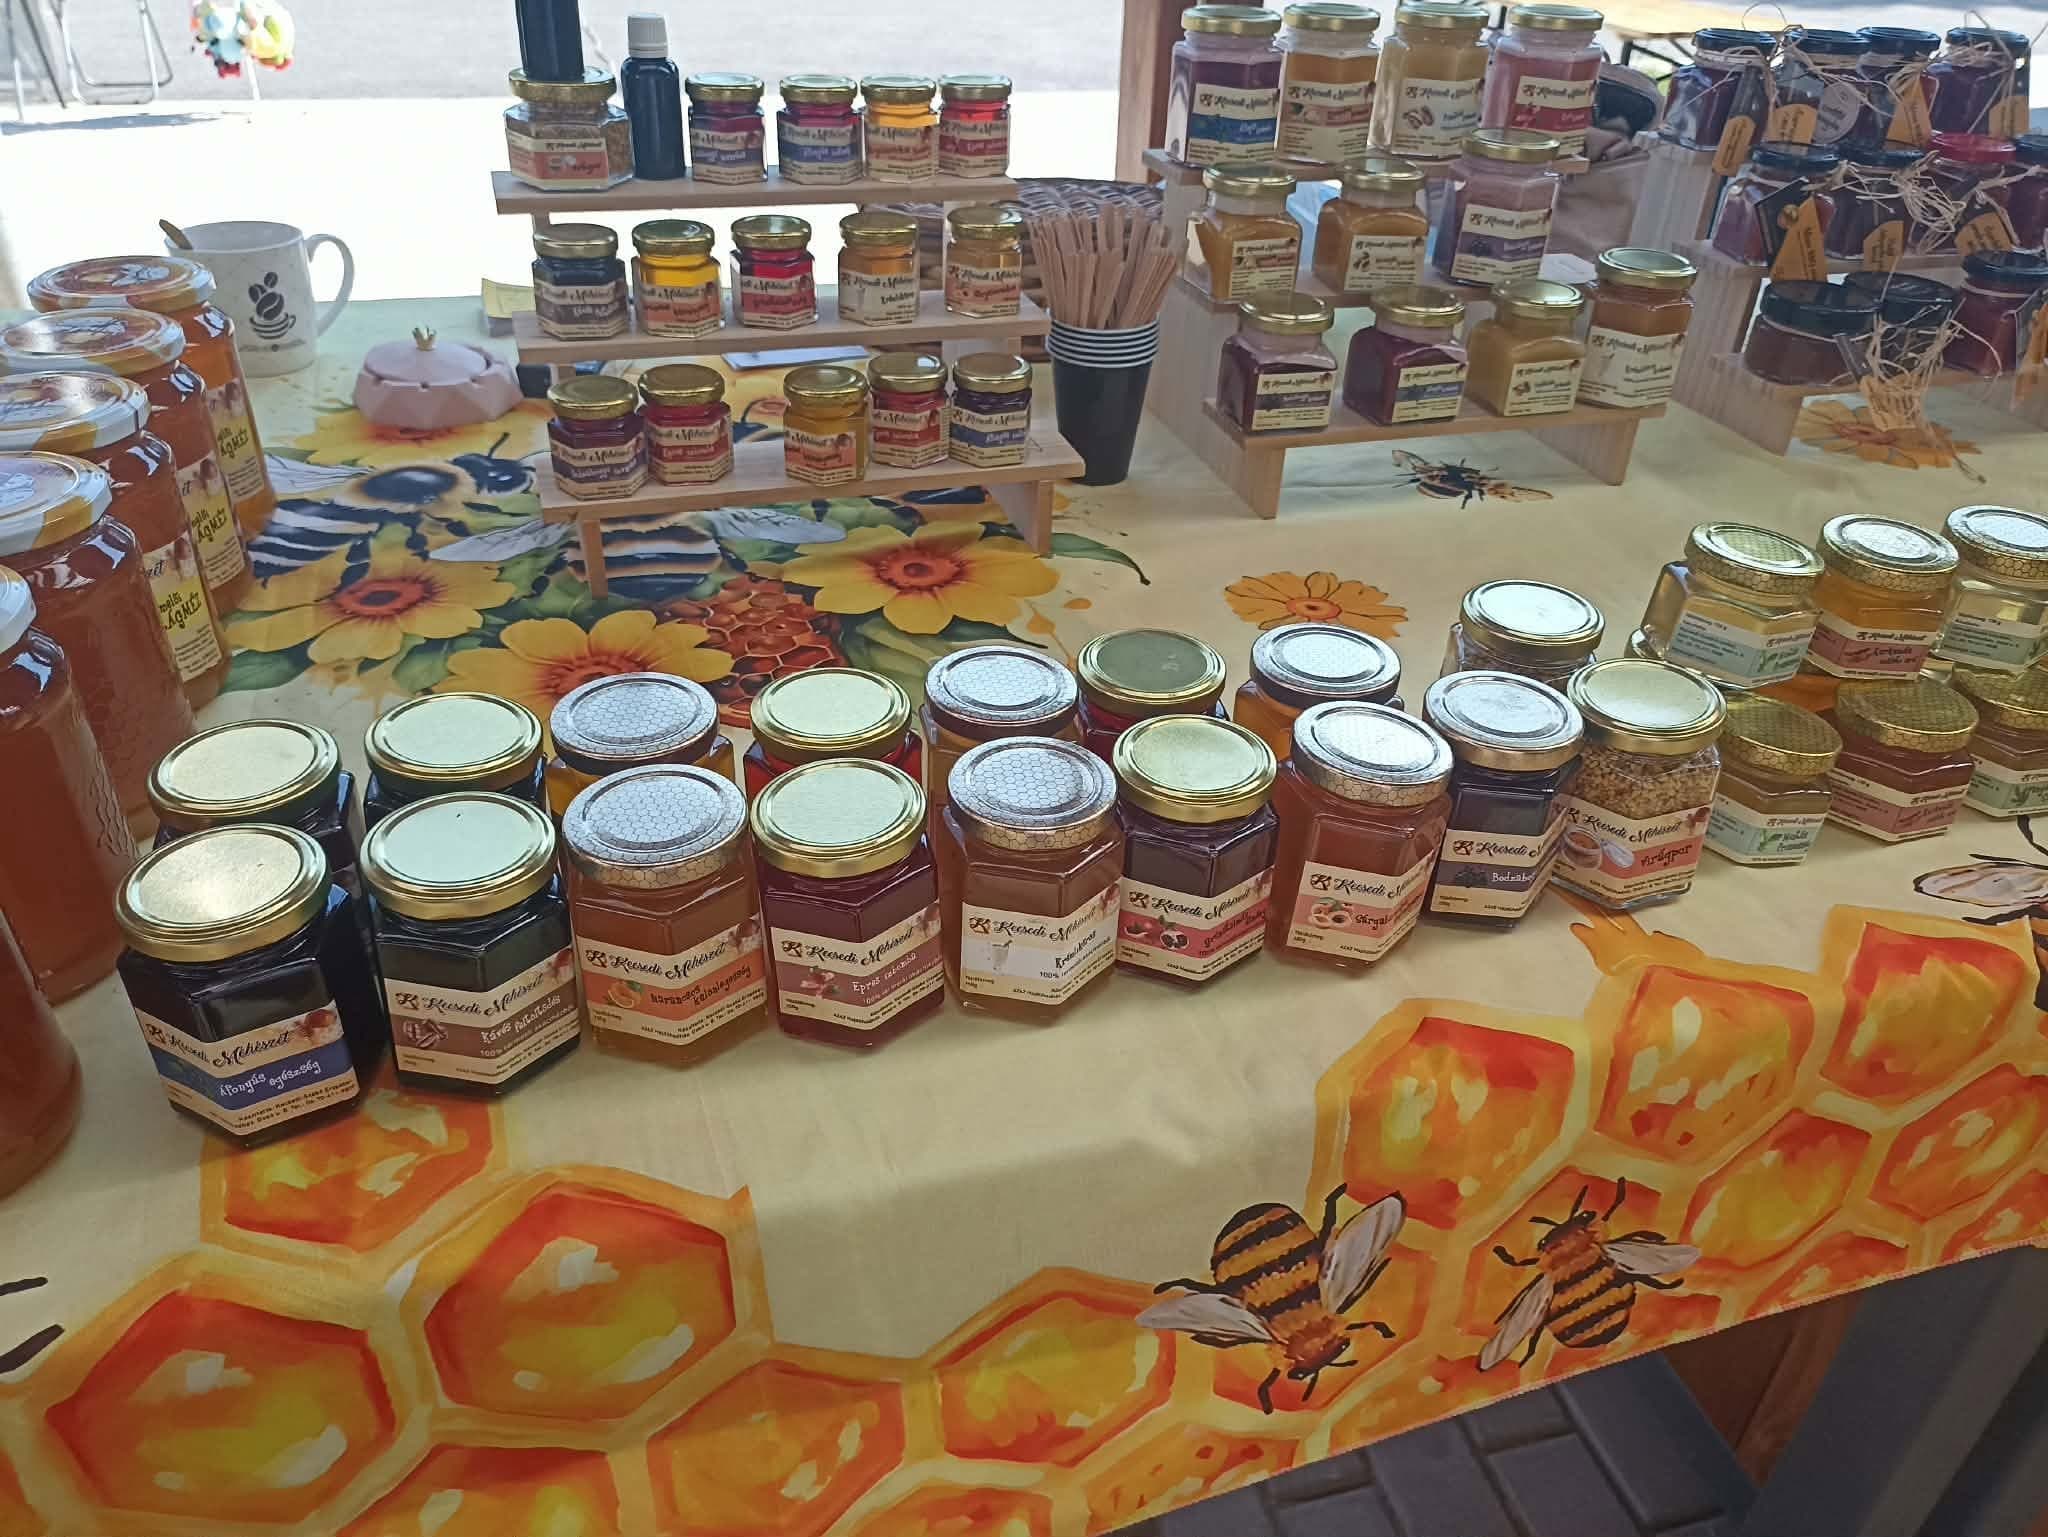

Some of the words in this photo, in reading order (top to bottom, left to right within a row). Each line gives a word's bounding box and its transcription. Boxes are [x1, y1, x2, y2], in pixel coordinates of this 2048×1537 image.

[1476, 842, 1528, 857] Kecsedi
[1334, 877, 1386, 897] Kecsedi
[1151, 896, 1203, 915] Kecsedi
[993, 920, 1048, 939] Kecsedi
[804, 944, 859, 963] Kecsedi
[609, 955, 664, 976] Kecsedi
[421, 996, 482, 1017] Kecsedi
[212, 1029, 292, 1068] Méhészet
[269, 1058, 322, 1090] egészség
